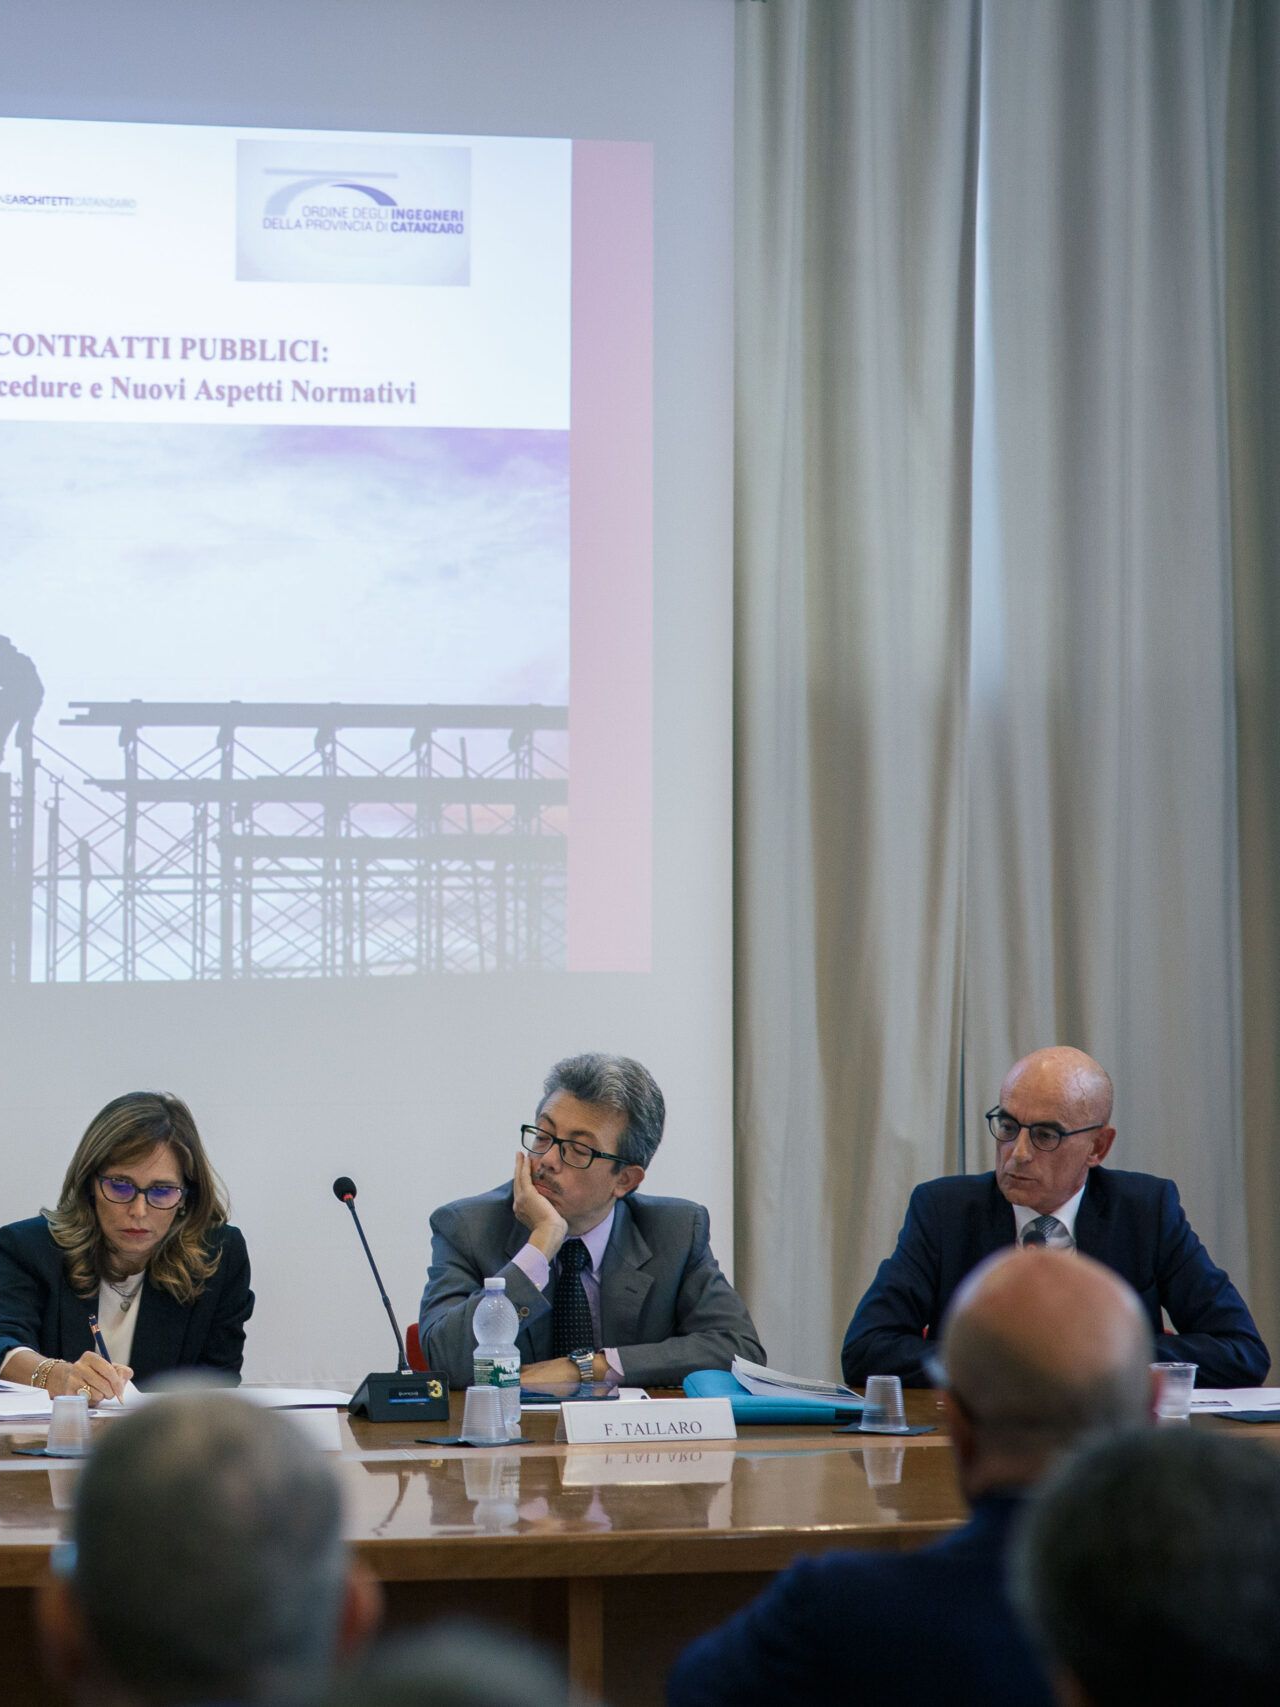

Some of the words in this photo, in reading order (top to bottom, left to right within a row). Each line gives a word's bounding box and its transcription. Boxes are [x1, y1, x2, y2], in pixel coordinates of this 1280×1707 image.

[301, 205, 349, 220] ORDINE
[352, 207, 388, 220] DEGLI
[391, 208, 464, 222] INGEGNERI
[263, 217, 302, 231] DELLA
[306, 219, 373, 233] PROVINCIA
[376, 221, 388, 233] DI
[390, 221, 465, 235] CATANZARO
[180, 336, 329, 363] PUBBLICI:
[89, 382, 103, 399] e
[111, 375, 187, 402] Nuovi
[194, 378, 283, 408] Aspetti
[291, 379, 417, 405] Normativi
[426, 1379, 443, 1398] 3
[604, 1423, 618, 1436] F.
[621, 1420, 702, 1436] TALLARO
